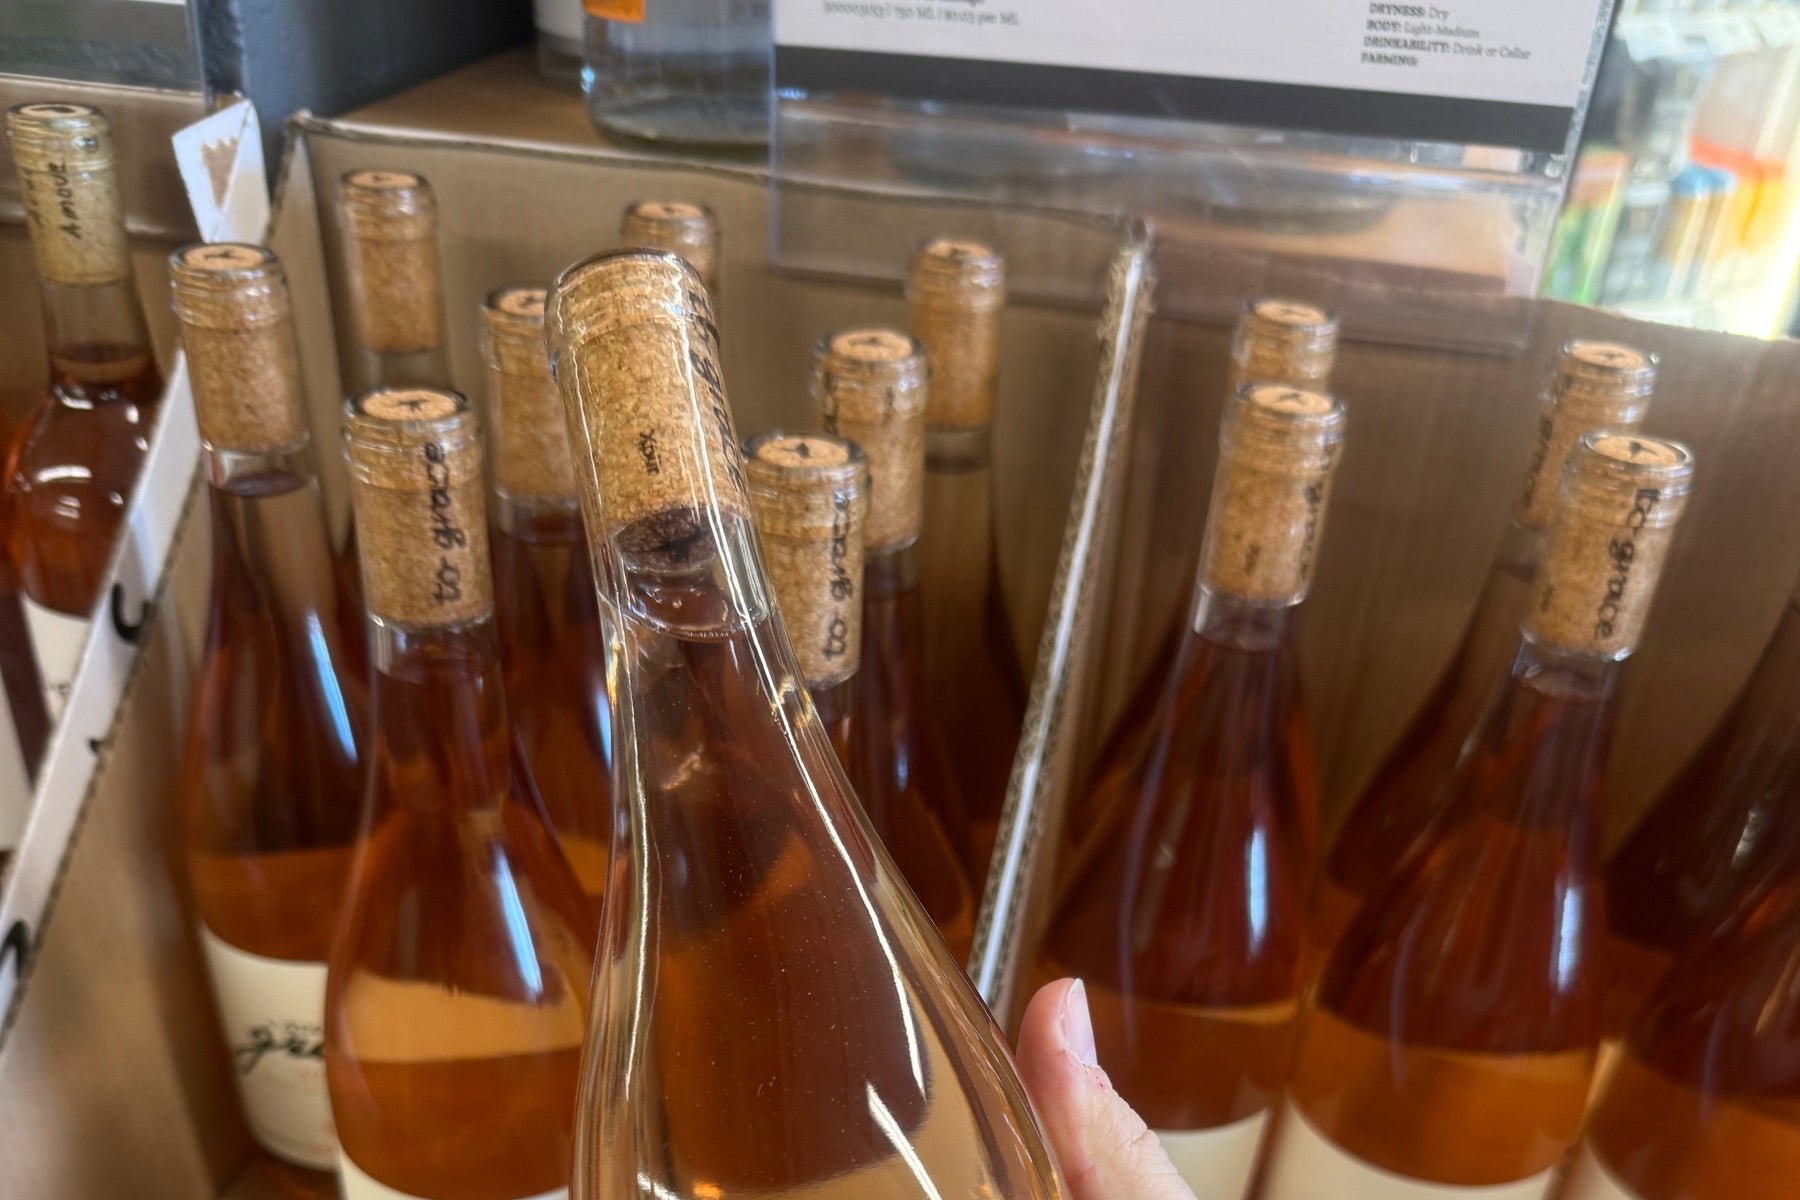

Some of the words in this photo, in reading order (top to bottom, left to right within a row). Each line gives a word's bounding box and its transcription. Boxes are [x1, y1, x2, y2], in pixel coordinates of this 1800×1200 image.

[1369, 2, 1425, 17] DRYNESS:
[1428, 7, 1449, 21] Dry
[1366, 19, 1401, 32] BODY:
[1403, 22, 1480, 38] Light-Medium
[1363, 36, 1450, 53] DRINKABILITY:
[1452, 44, 1484, 57] Drink
[1485, 48, 1498, 57] or
[432, 556, 462, 604] to
[822, 612, 848, 661] to
